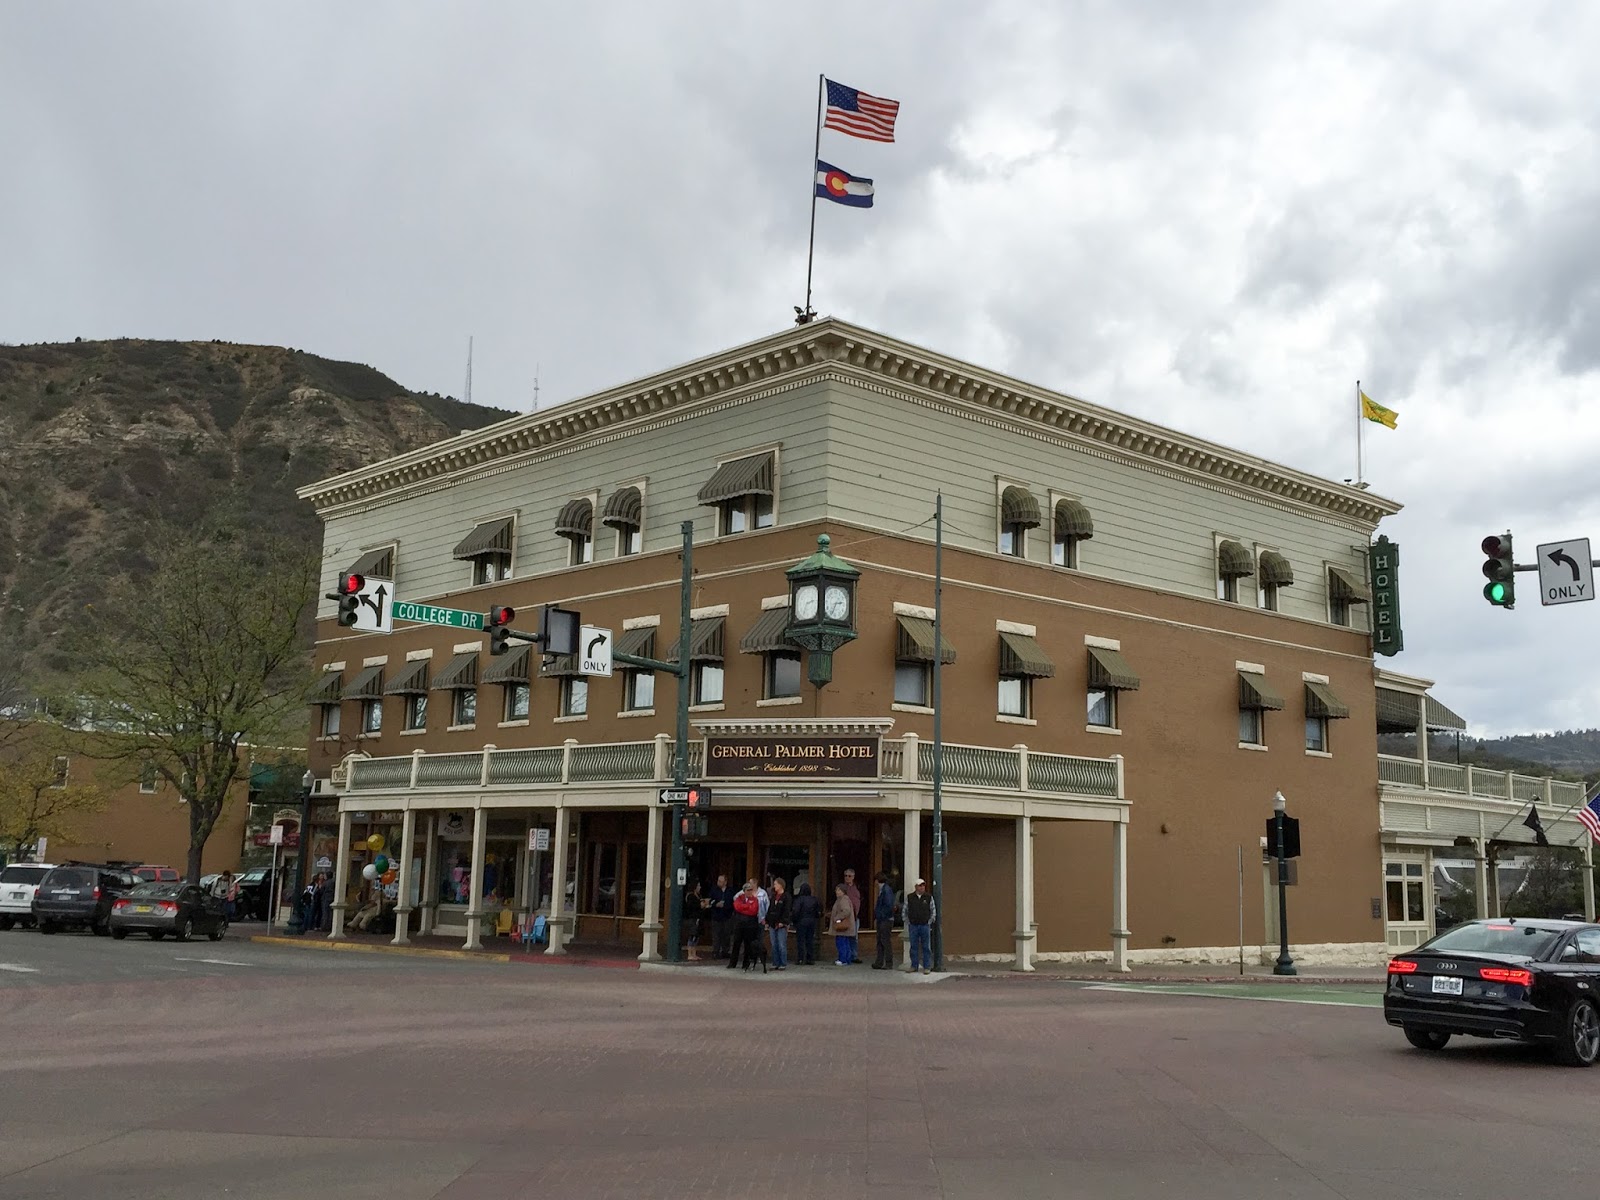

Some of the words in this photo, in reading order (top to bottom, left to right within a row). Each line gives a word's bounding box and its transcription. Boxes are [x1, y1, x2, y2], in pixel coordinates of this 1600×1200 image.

[1375, 555, 1391, 643] HOTEL
[1549, 584, 1586, 600] ONLY
[398, 603, 453, 624] COLLEGE
[461, 613, 477, 628] DR
[583, 660, 607, 672] ONLY
[763, 762, 797, 772] Established
[798, 764, 819, 772] 1898
